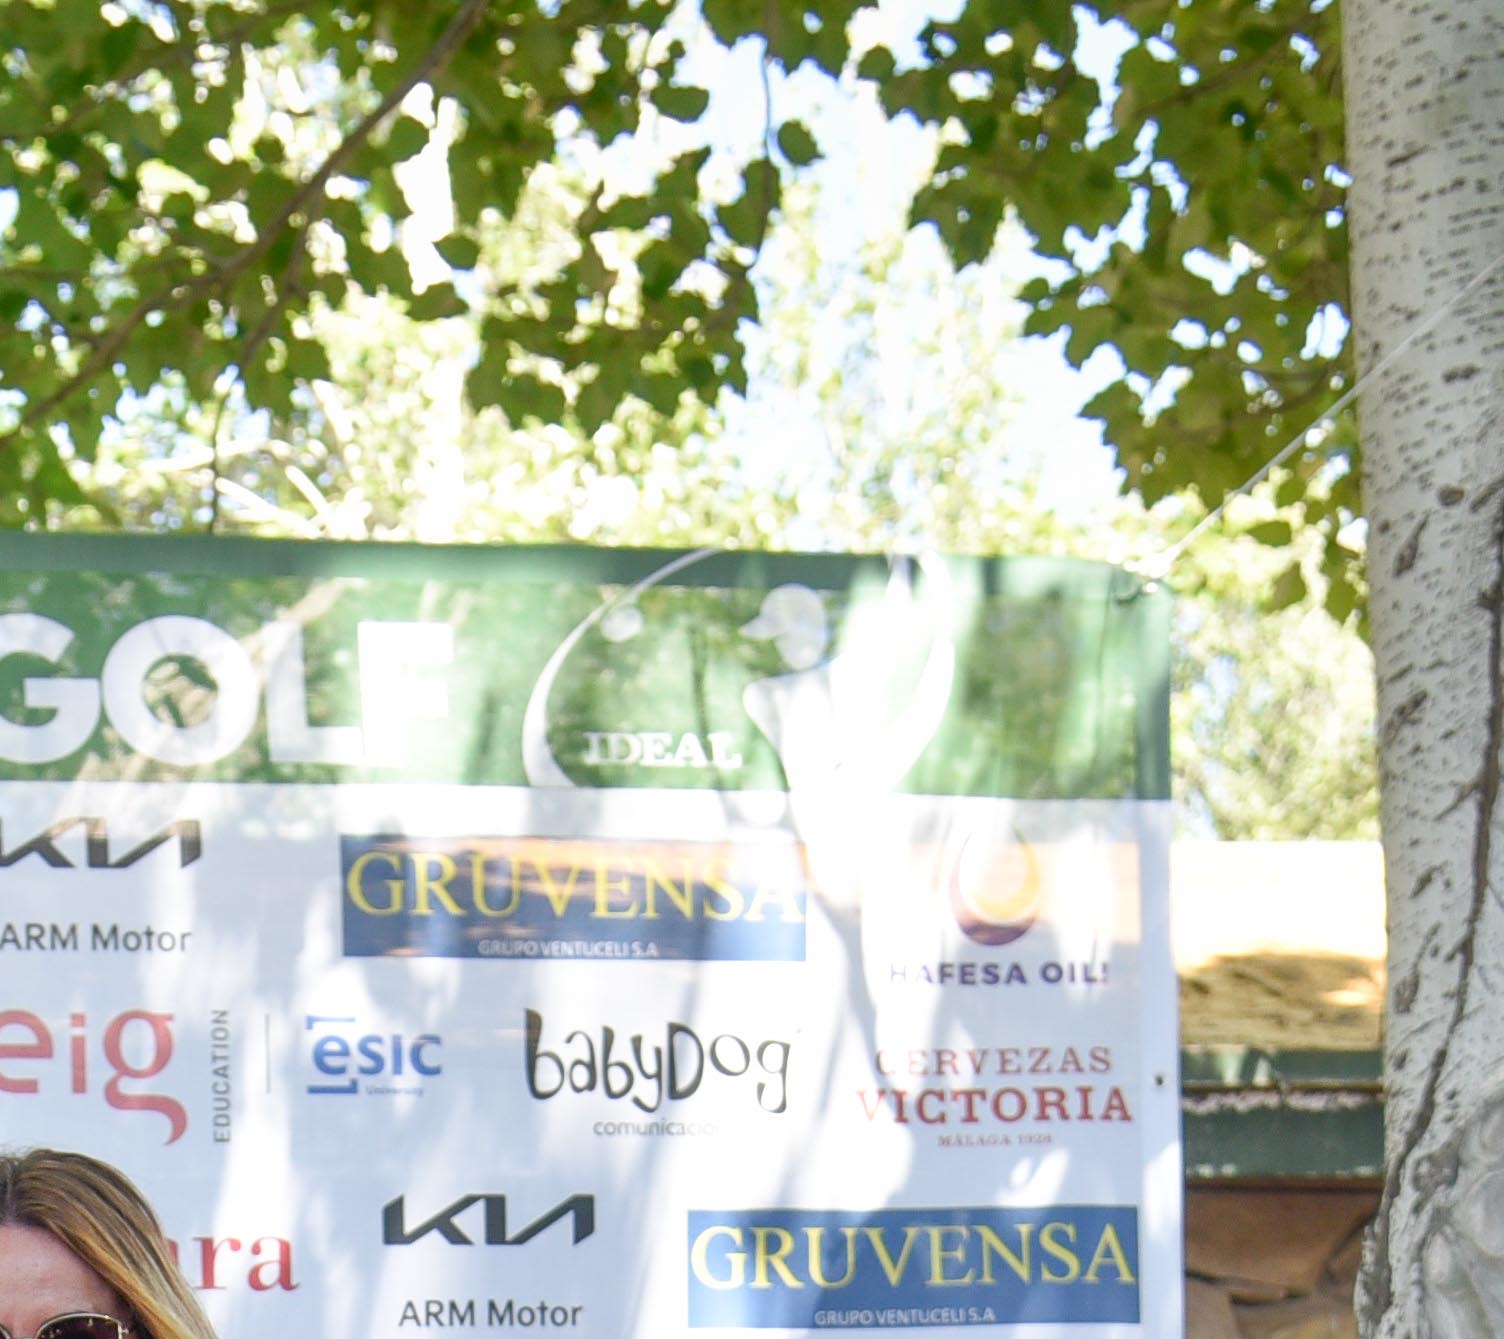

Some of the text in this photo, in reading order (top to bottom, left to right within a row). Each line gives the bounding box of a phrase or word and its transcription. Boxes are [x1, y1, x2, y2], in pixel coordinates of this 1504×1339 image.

[583, 731, 742, 770] IDEAL
[346, 848, 806, 926] GRUVENSA
[89, 922, 192, 952] Motor
[478, 940, 541, 958] GRUPO
[1040, 959, 1111, 987] OIL!
[212, 1008, 230, 1144] EDUCATION
[876, 1046, 1113, 1076] CERVEZAS
[857, 1087, 1133, 1123] VICTORIA
[690, 1221, 1136, 1291] GRUVENSA
[398, 1300, 583, 1328] ARM Motor
[814, 1308, 967, 1326] GRUPO VENTUCELI
